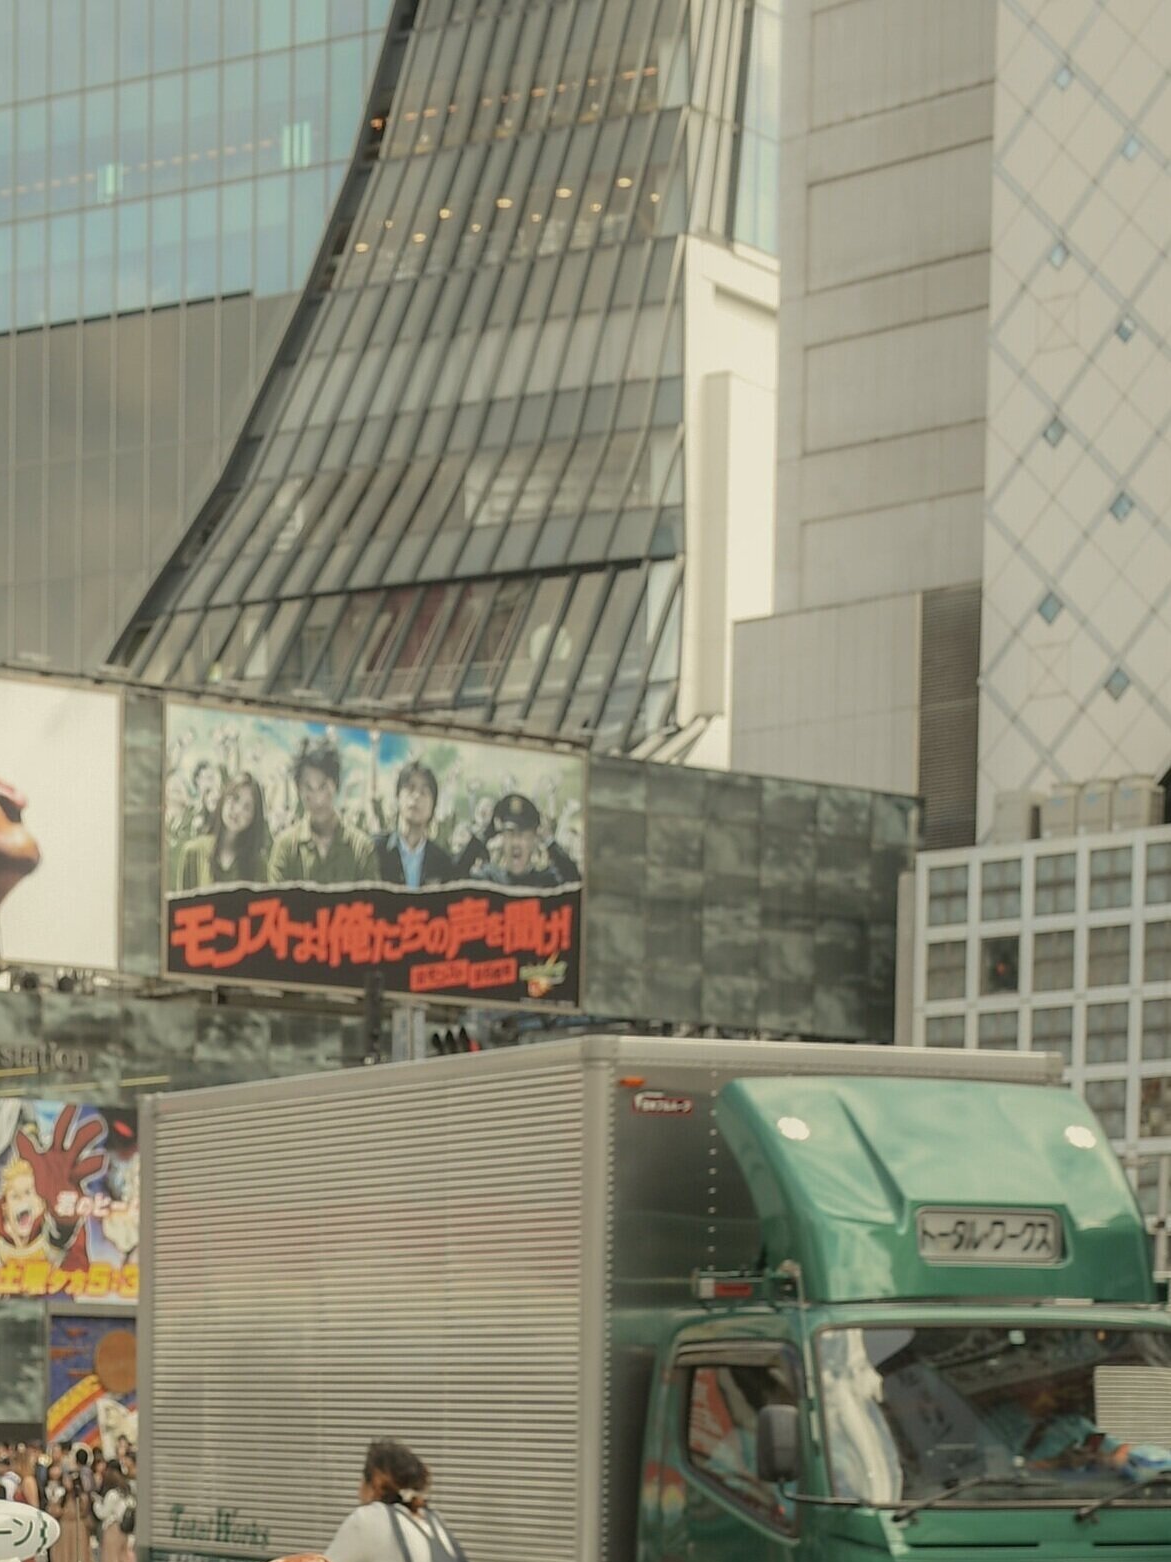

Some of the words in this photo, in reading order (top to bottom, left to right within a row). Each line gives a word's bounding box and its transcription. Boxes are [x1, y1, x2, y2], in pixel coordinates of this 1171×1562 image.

[0, 1041, 90, 1073] station
[54, 1190, 139, 1217] 僕のヒー
[921, 1218, 1052, 1252] トータルワークス
